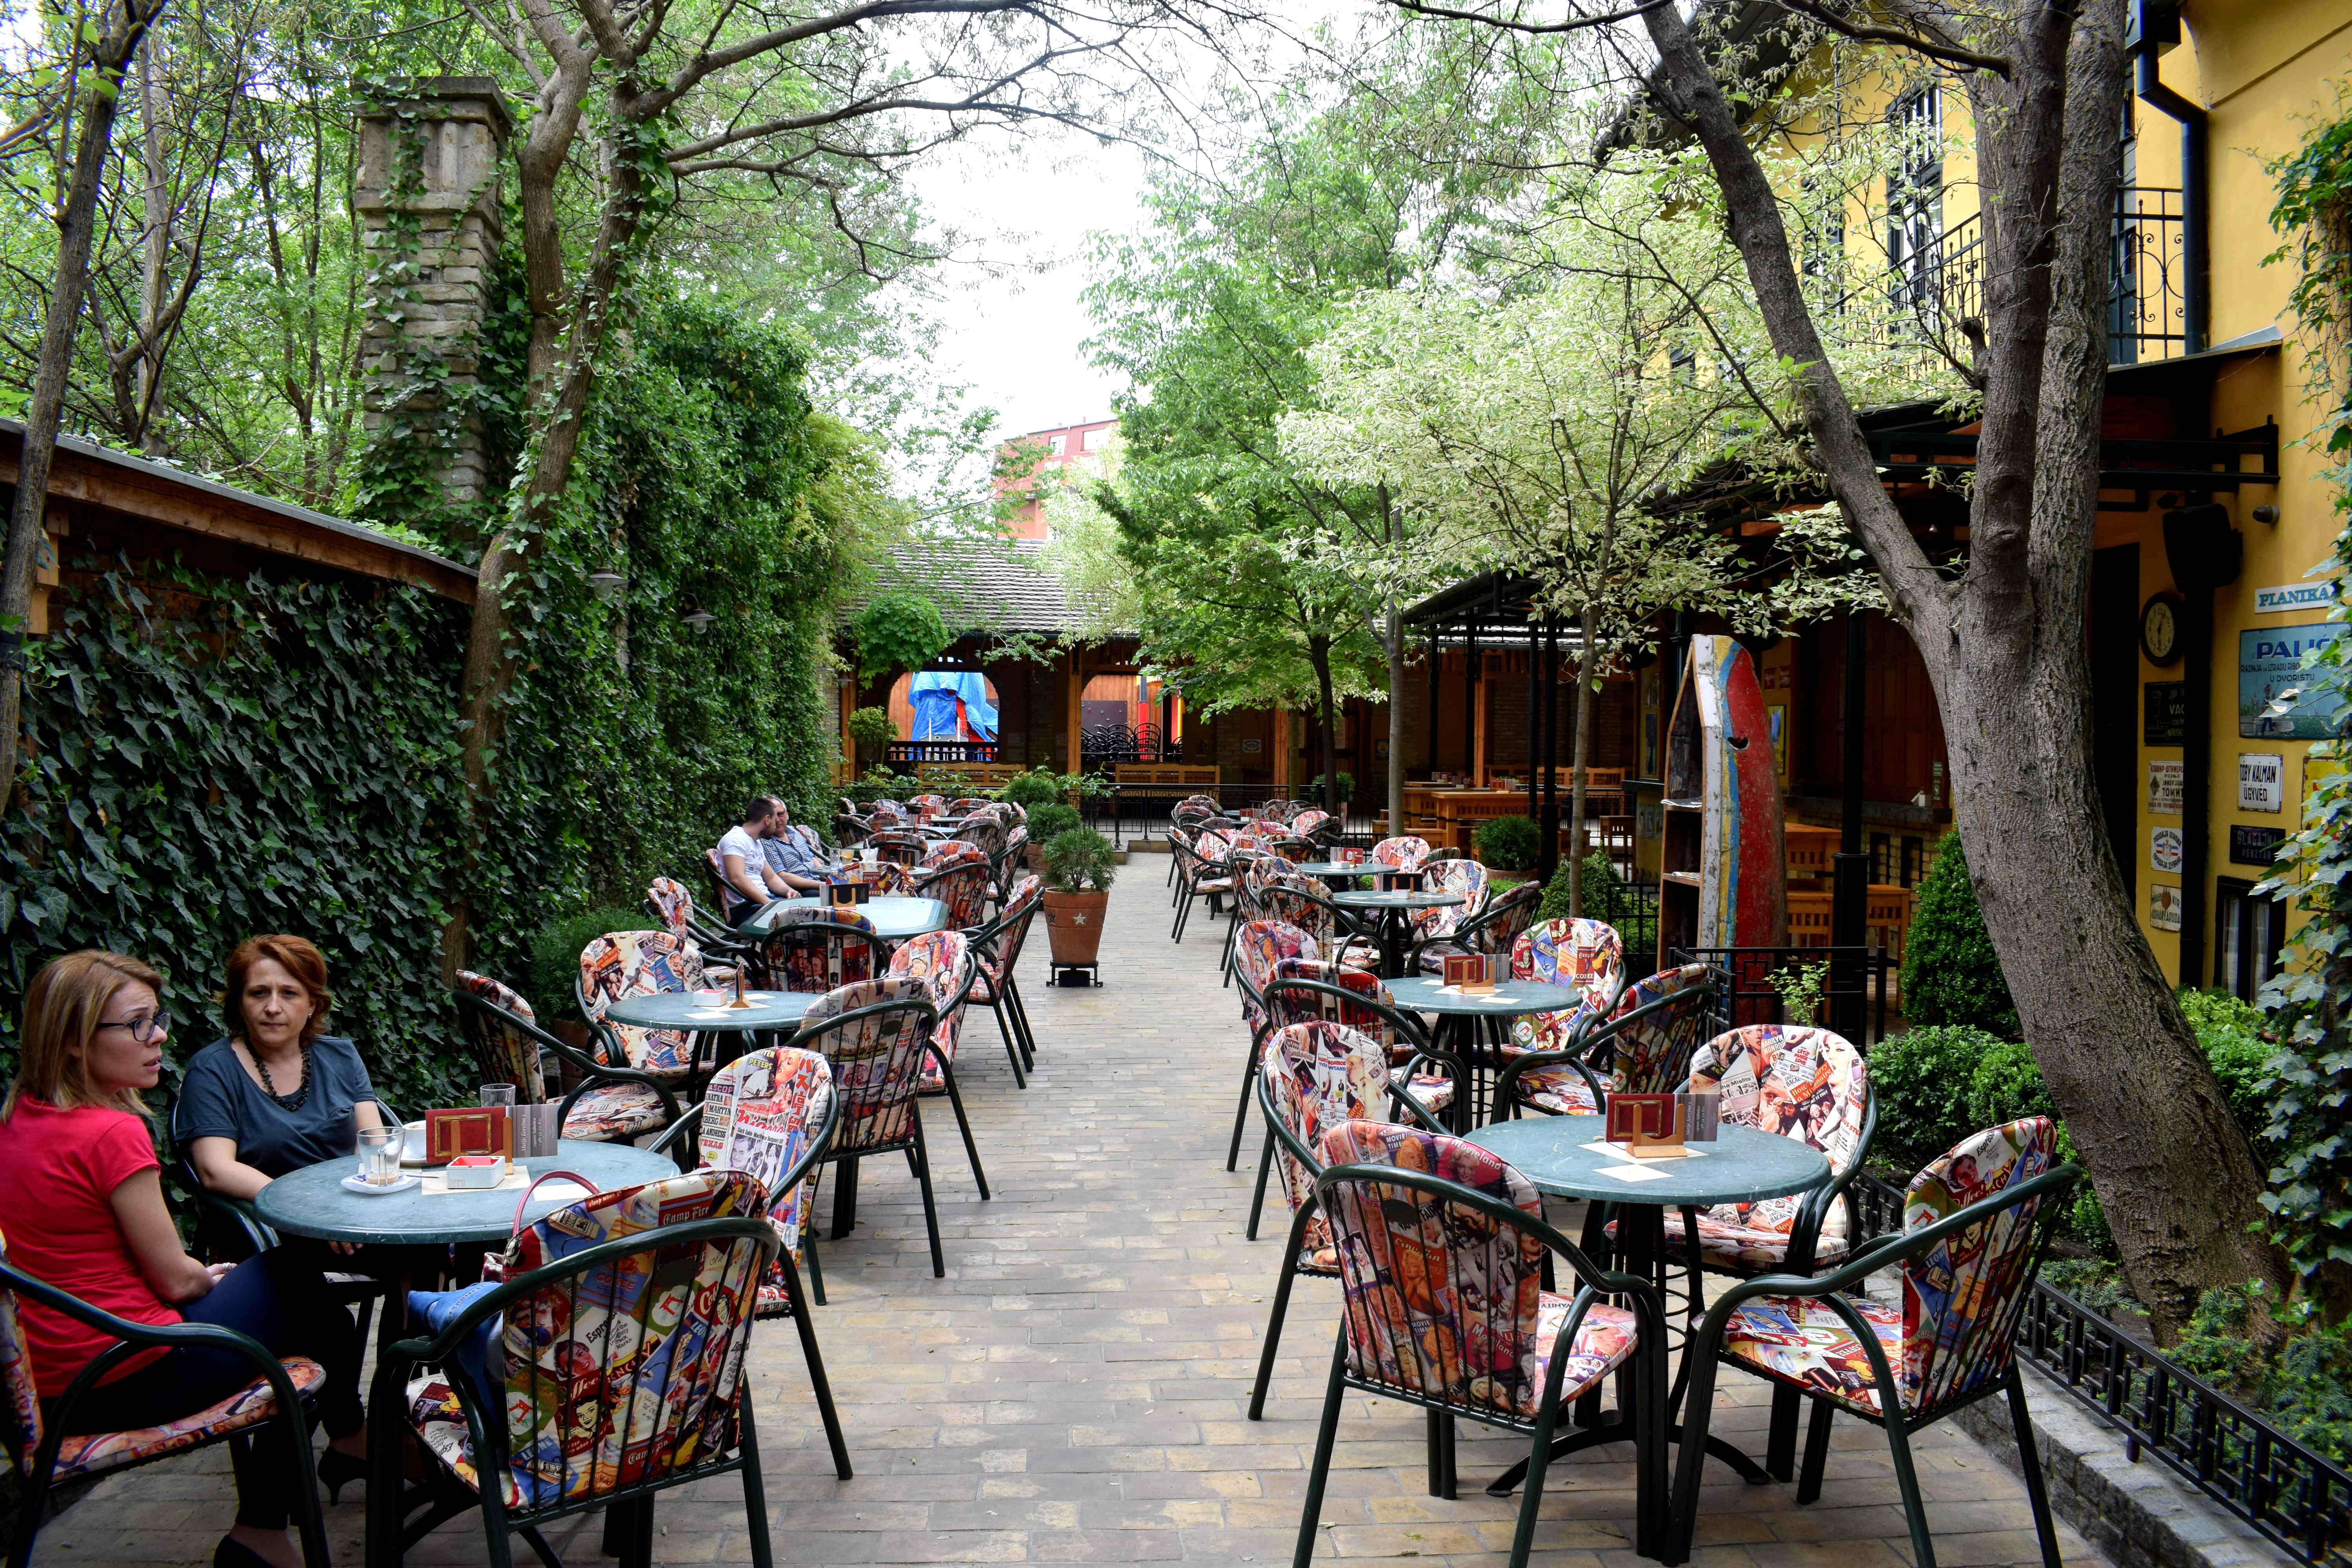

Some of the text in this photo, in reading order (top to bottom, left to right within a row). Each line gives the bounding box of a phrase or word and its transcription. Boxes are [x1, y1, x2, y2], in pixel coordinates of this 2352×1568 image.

[2258, 587, 2330, 607] PLANIKA
[2268, 663, 2287, 671] IZRADU
[2276, 673, 2314, 682] DVORIŠTU
[2252, 761, 2276, 783] KÁLMÁN
[2243, 784, 2267, 802] ÜGYVÉD
[1536, 933, 1548, 942] LEONE
[643, 985, 655, 995] STOP
[748, 1058, 773, 1070] PETERS
[1795, 1057, 1807, 1065] LOVE
[709, 1105, 731, 1116] MARTIN
[705, 1128, 726, 1138] ANDRESS
[1386, 1134, 1405, 1143] MOVIE
[1388, 1142, 1402, 1150] TIME
[1451, 1138, 1501, 1171] Movieland
[588, 1197, 602, 1208] sleep
[663, 1206, 709, 1226] Camp Fire
[690, 1321, 709, 1338] LEON
[1835, 1344, 1863, 1357] COFFEE
